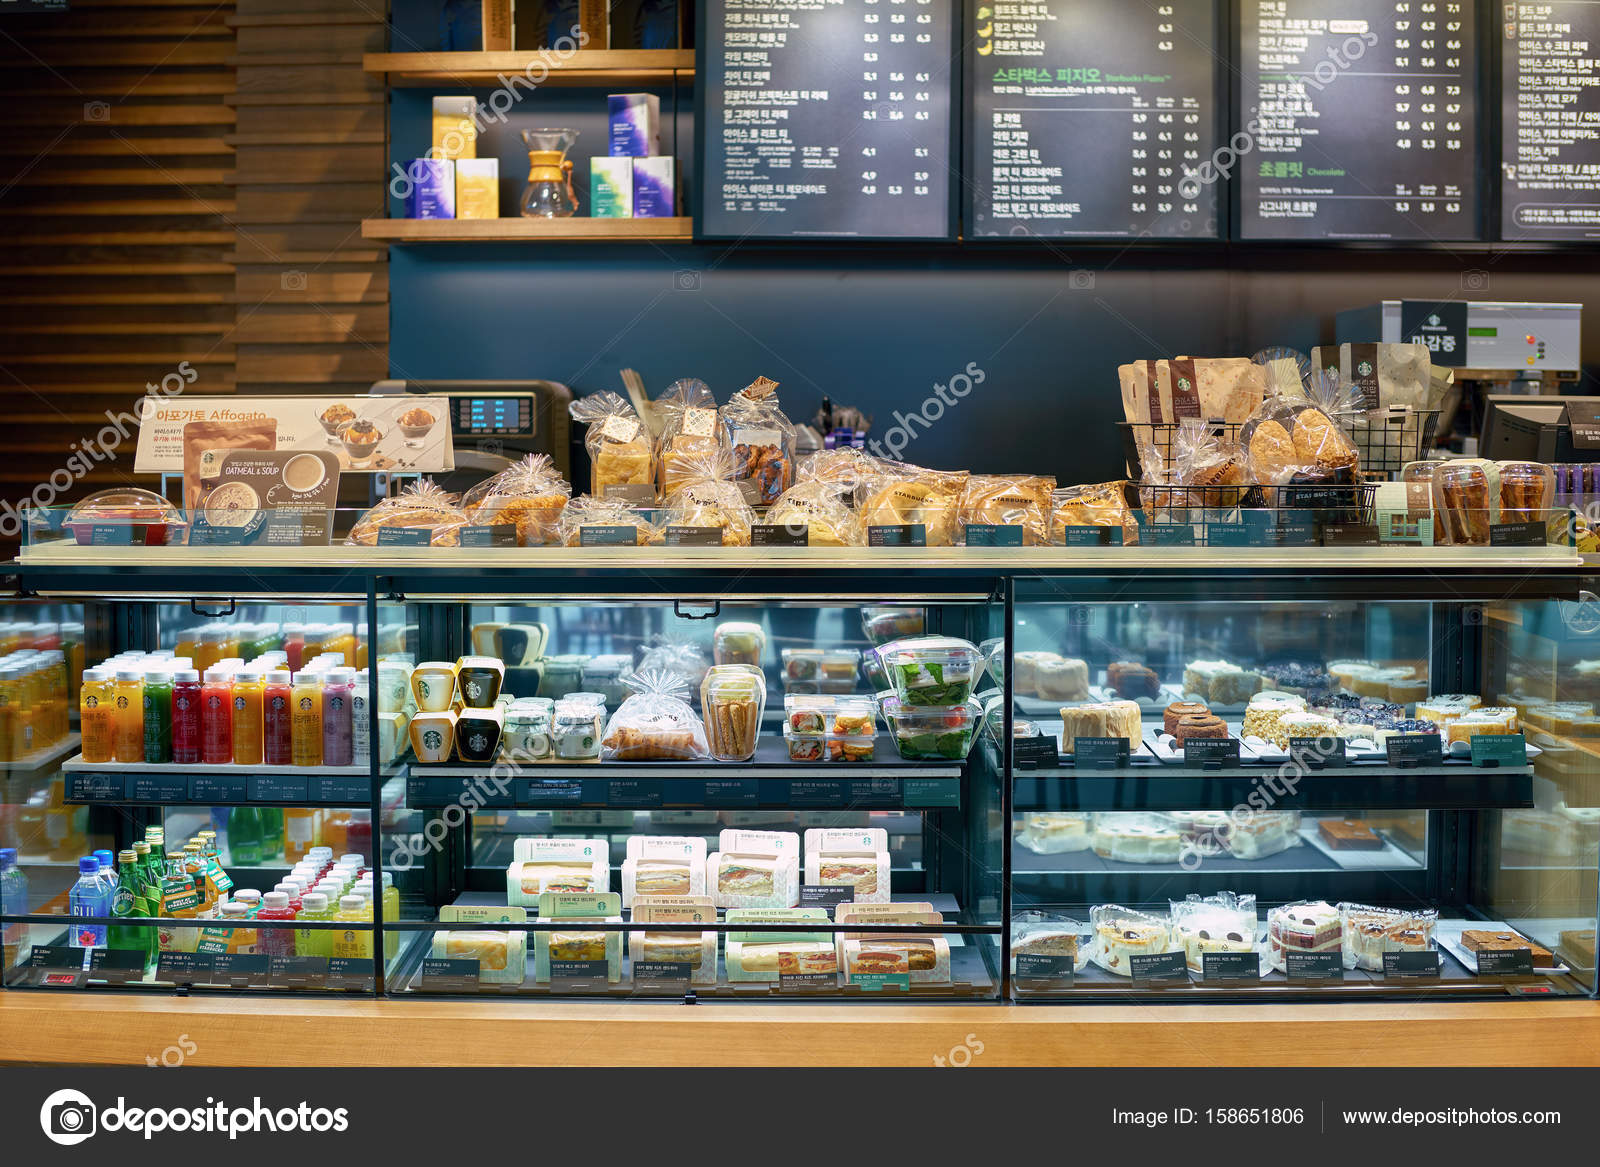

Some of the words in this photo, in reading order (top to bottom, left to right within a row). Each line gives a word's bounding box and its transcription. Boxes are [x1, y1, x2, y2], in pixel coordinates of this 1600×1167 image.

[992, 68, 1052, 83] 스타벅스
[1056, 68, 1102, 84] 피지오
[1258, 161, 1303, 178] 초콜릿
[1412, 335, 1456, 352] 마감중
[156, 410, 206, 422] 아포가토
[225, 466, 255, 475] OATMEAL
[262, 466, 280, 475] SOUP
[165, 886, 184, 894] Organic
